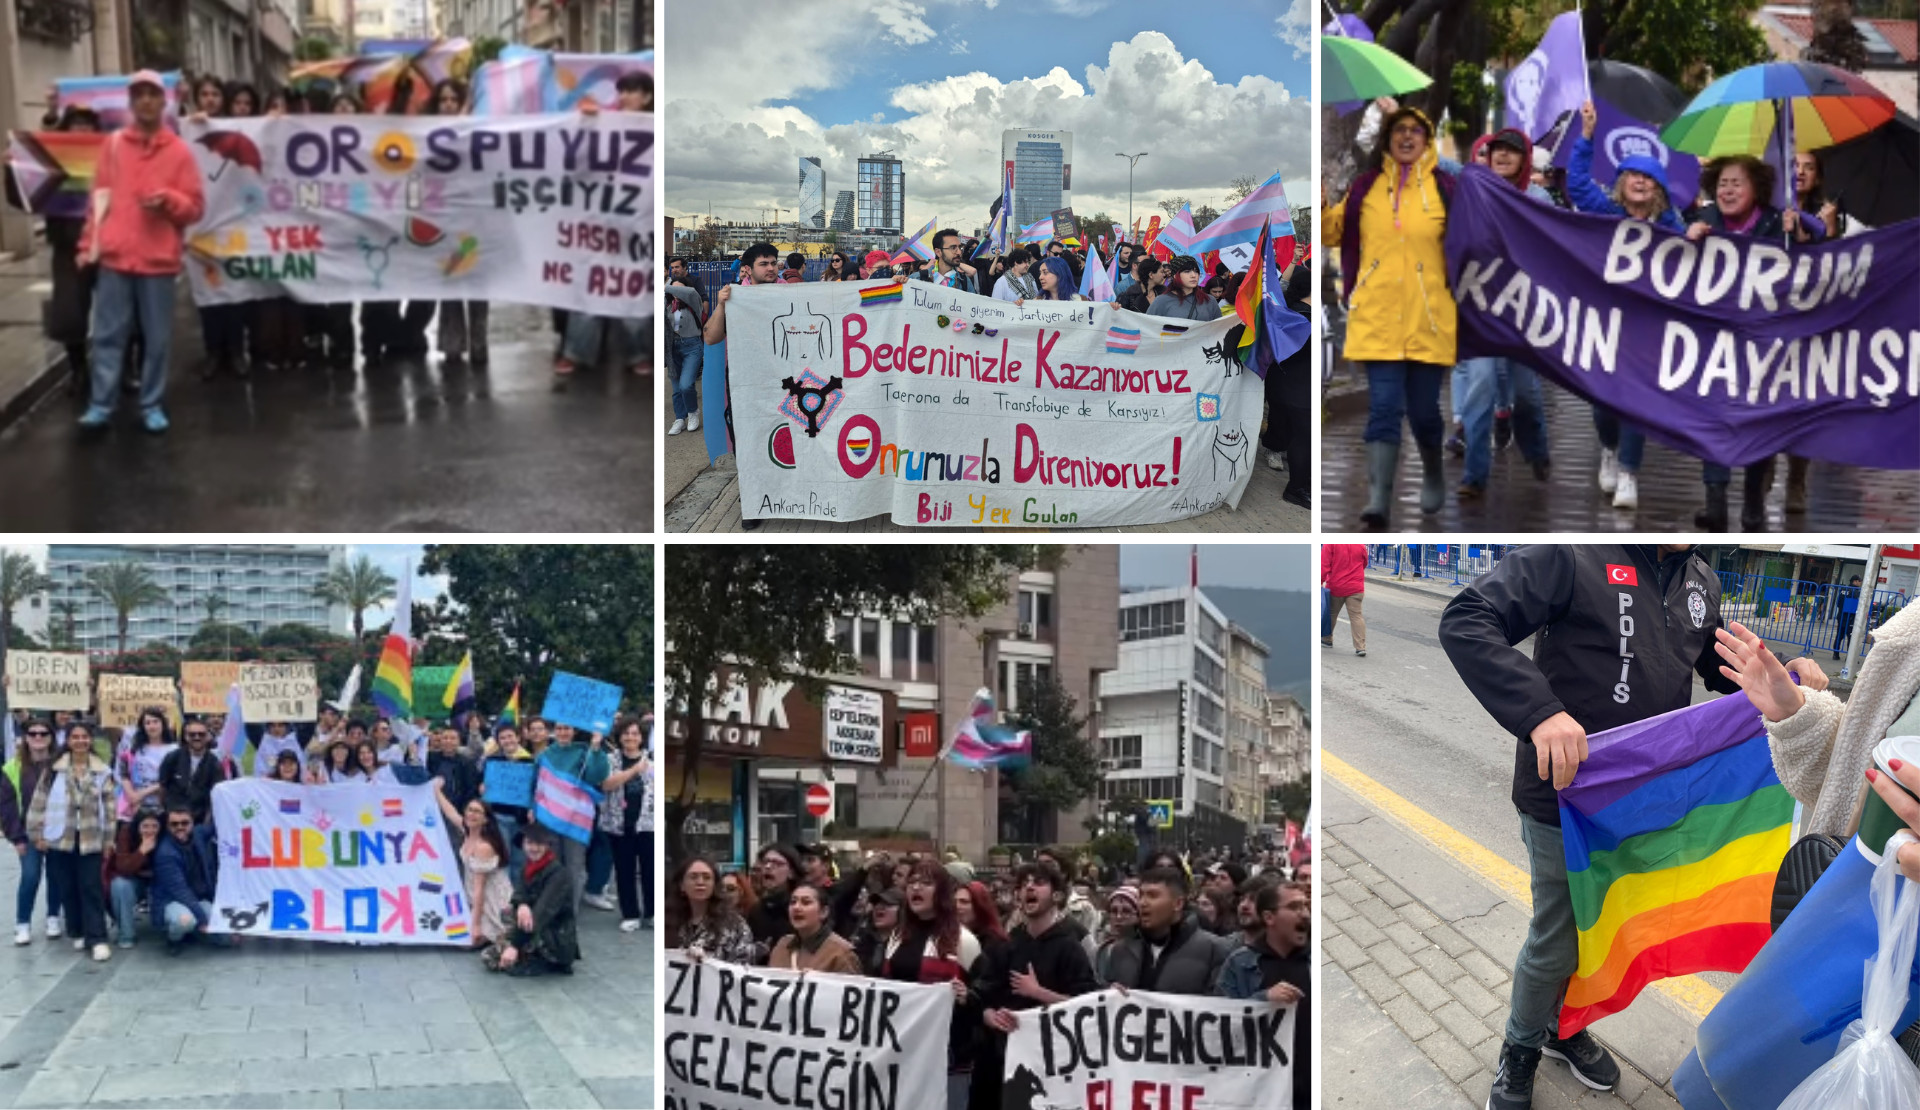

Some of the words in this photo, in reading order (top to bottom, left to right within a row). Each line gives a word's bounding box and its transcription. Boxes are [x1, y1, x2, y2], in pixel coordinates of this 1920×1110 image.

[225, 253, 316, 280] GULAN
[264, 223, 324, 251] YEK
[1603, 218, 1875, 313] BODRUM
[910, 287, 942, 310] Tulum
[949, 298, 968, 313] da
[1456, 257, 1622, 374] KADIN
[842, 313, 1022, 383] Bedenimizle
[952, 390, 970, 405] da
[993, 392, 1070, 420] Transfobiye
[1077, 399, 1092, 417] de
[837, 413, 1000, 484] Onrumuzla
[1022, 497, 1078, 524] Gulan
[1612, 592, 1635, 704] POLİS
[241, 826, 439, 869] LUBUNYA
[270, 884, 416, 935] BLOK
[715, 968, 826, 1039] REZİL
[838, 982, 902, 1052] BİR
[664, 1031, 900, 1110] GELECEĞİN
